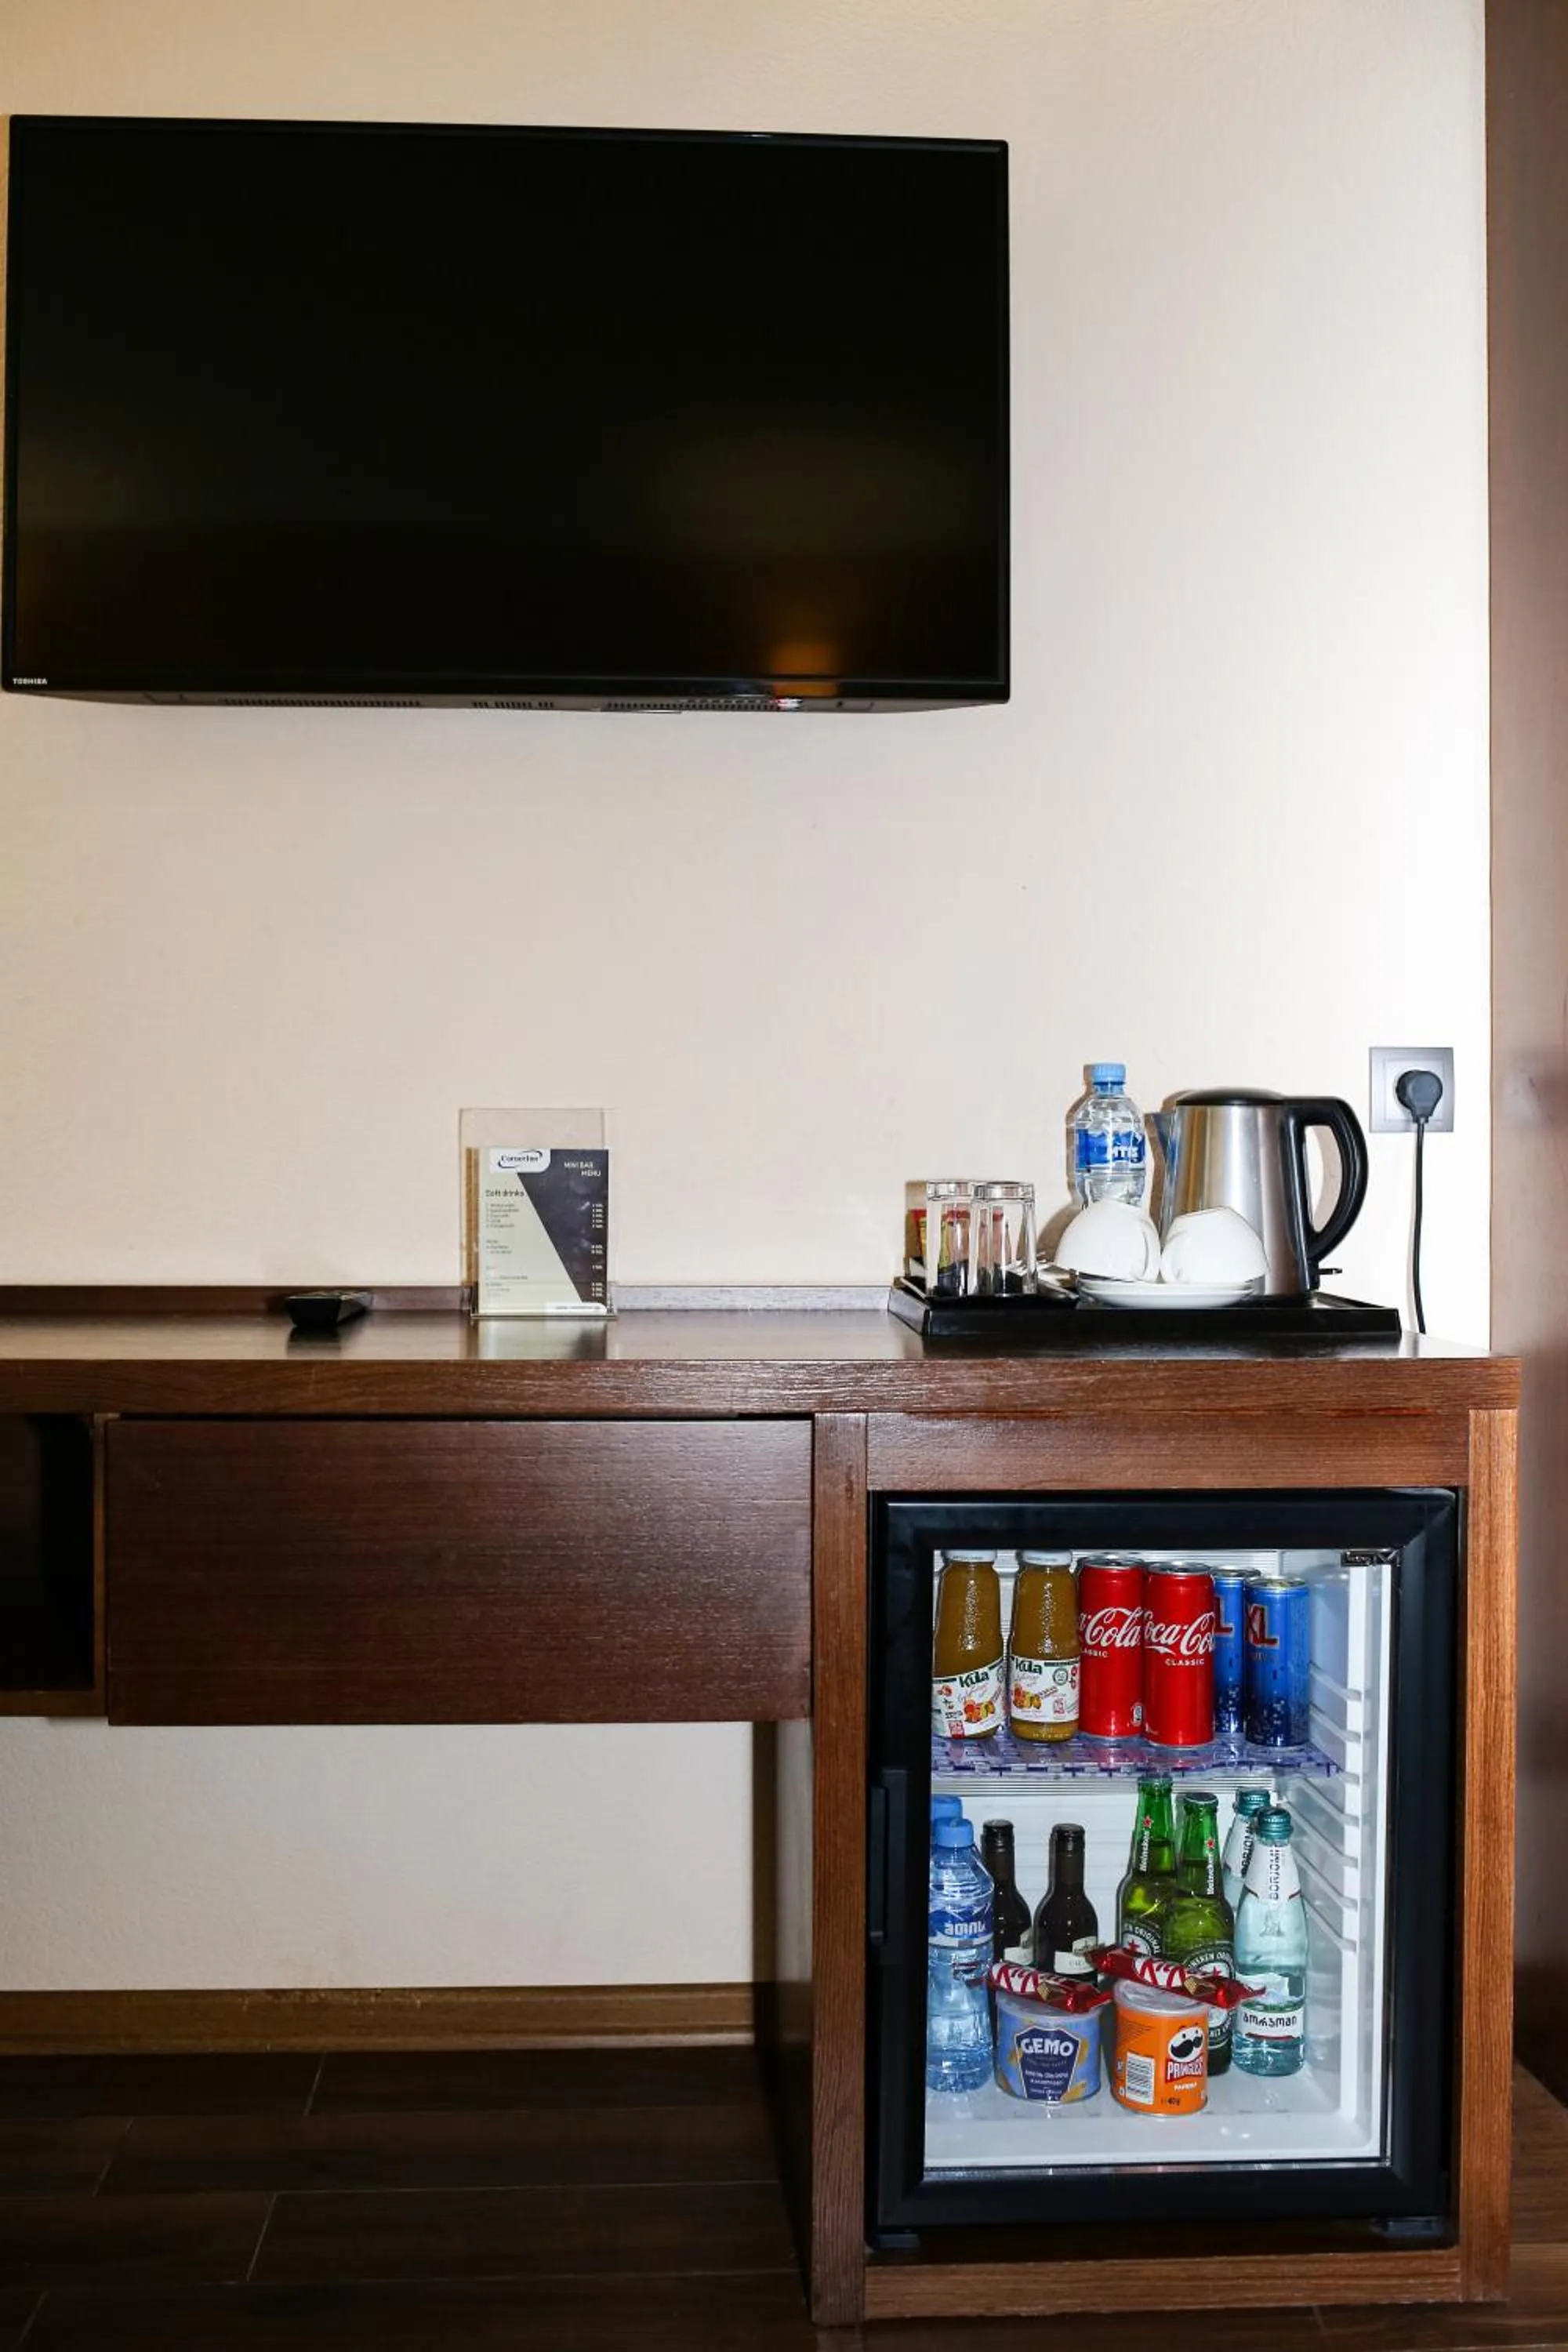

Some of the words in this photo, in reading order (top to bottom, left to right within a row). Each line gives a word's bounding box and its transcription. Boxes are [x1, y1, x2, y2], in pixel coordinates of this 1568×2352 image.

[1015, 1657, 1043, 1675] Kula
[1164, 1658, 1205, 1667] CLASSIC
[959, 1670, 989, 1688] Kula
[1269, 1843, 1279, 1900] BORJOMI
[1021, 2038, 1074, 2056] GEMO
